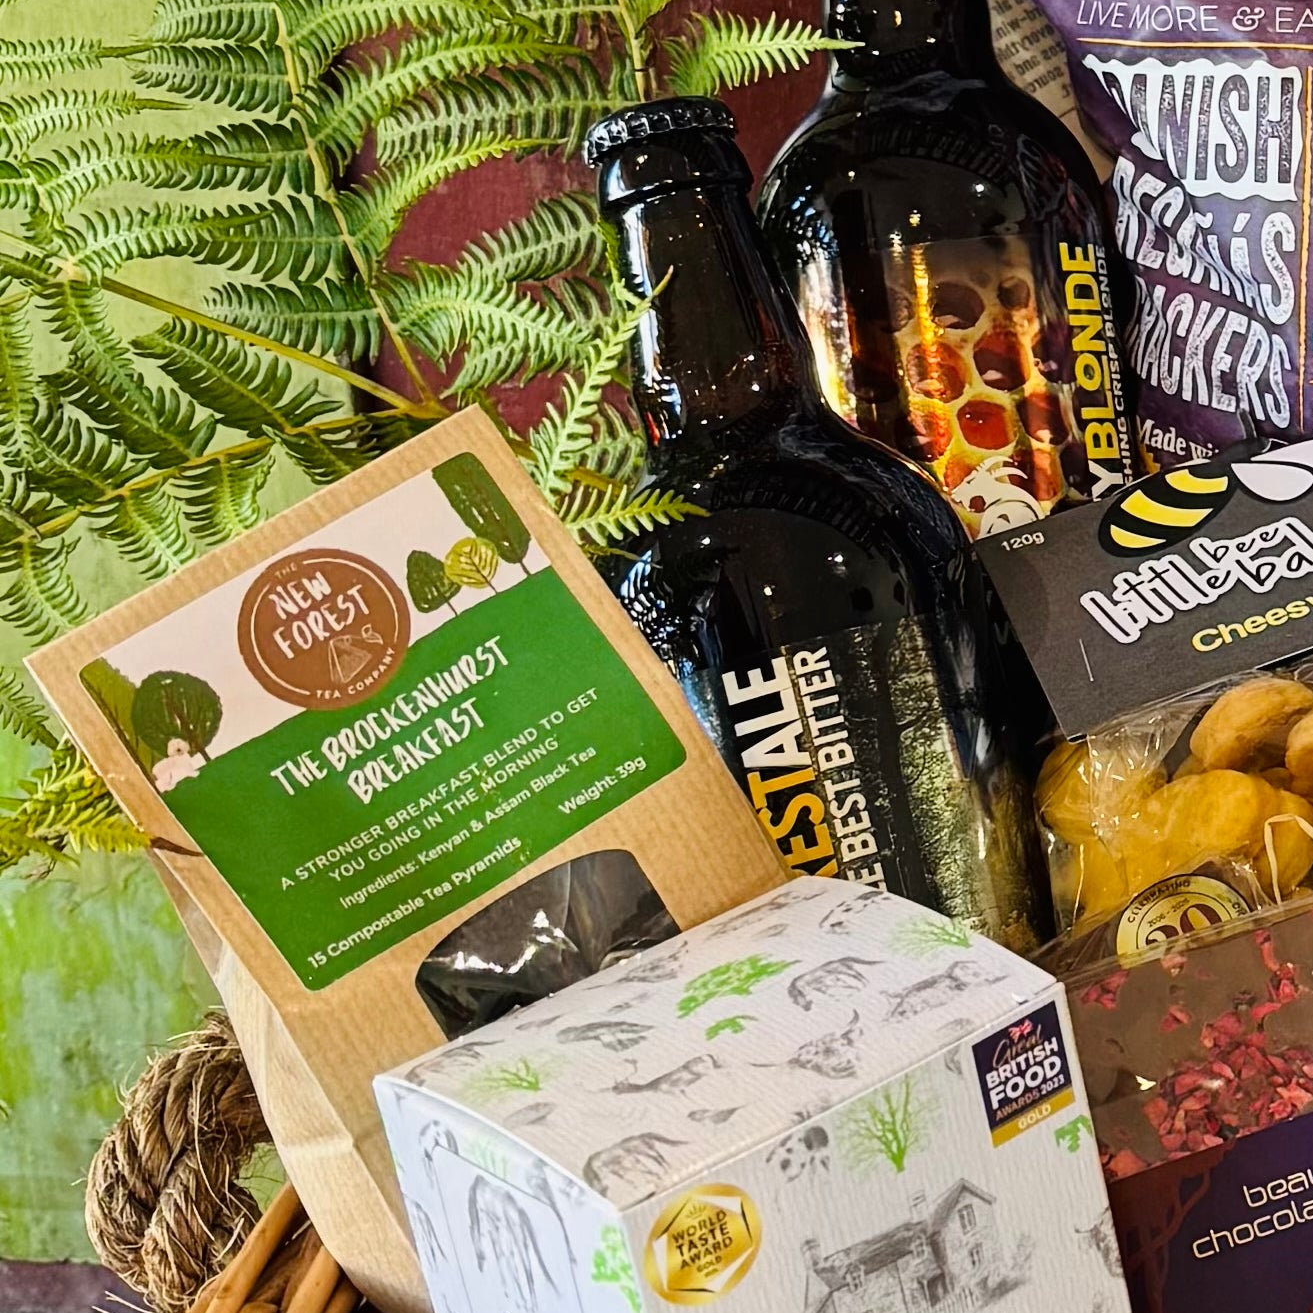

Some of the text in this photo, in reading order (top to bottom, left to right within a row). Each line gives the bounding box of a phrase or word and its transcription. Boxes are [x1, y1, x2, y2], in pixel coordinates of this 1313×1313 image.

[1001, 531, 1045, 551] 120g
[269, 636, 511, 797] THE BROCKENHURST
[347, 697, 486, 805] BREAKFAST
[795, 647, 857, 766] BITTER
[615, 754, 648, 785] 39g
[307, 836, 522, 969] 15 Compostable Tea Pyramids
